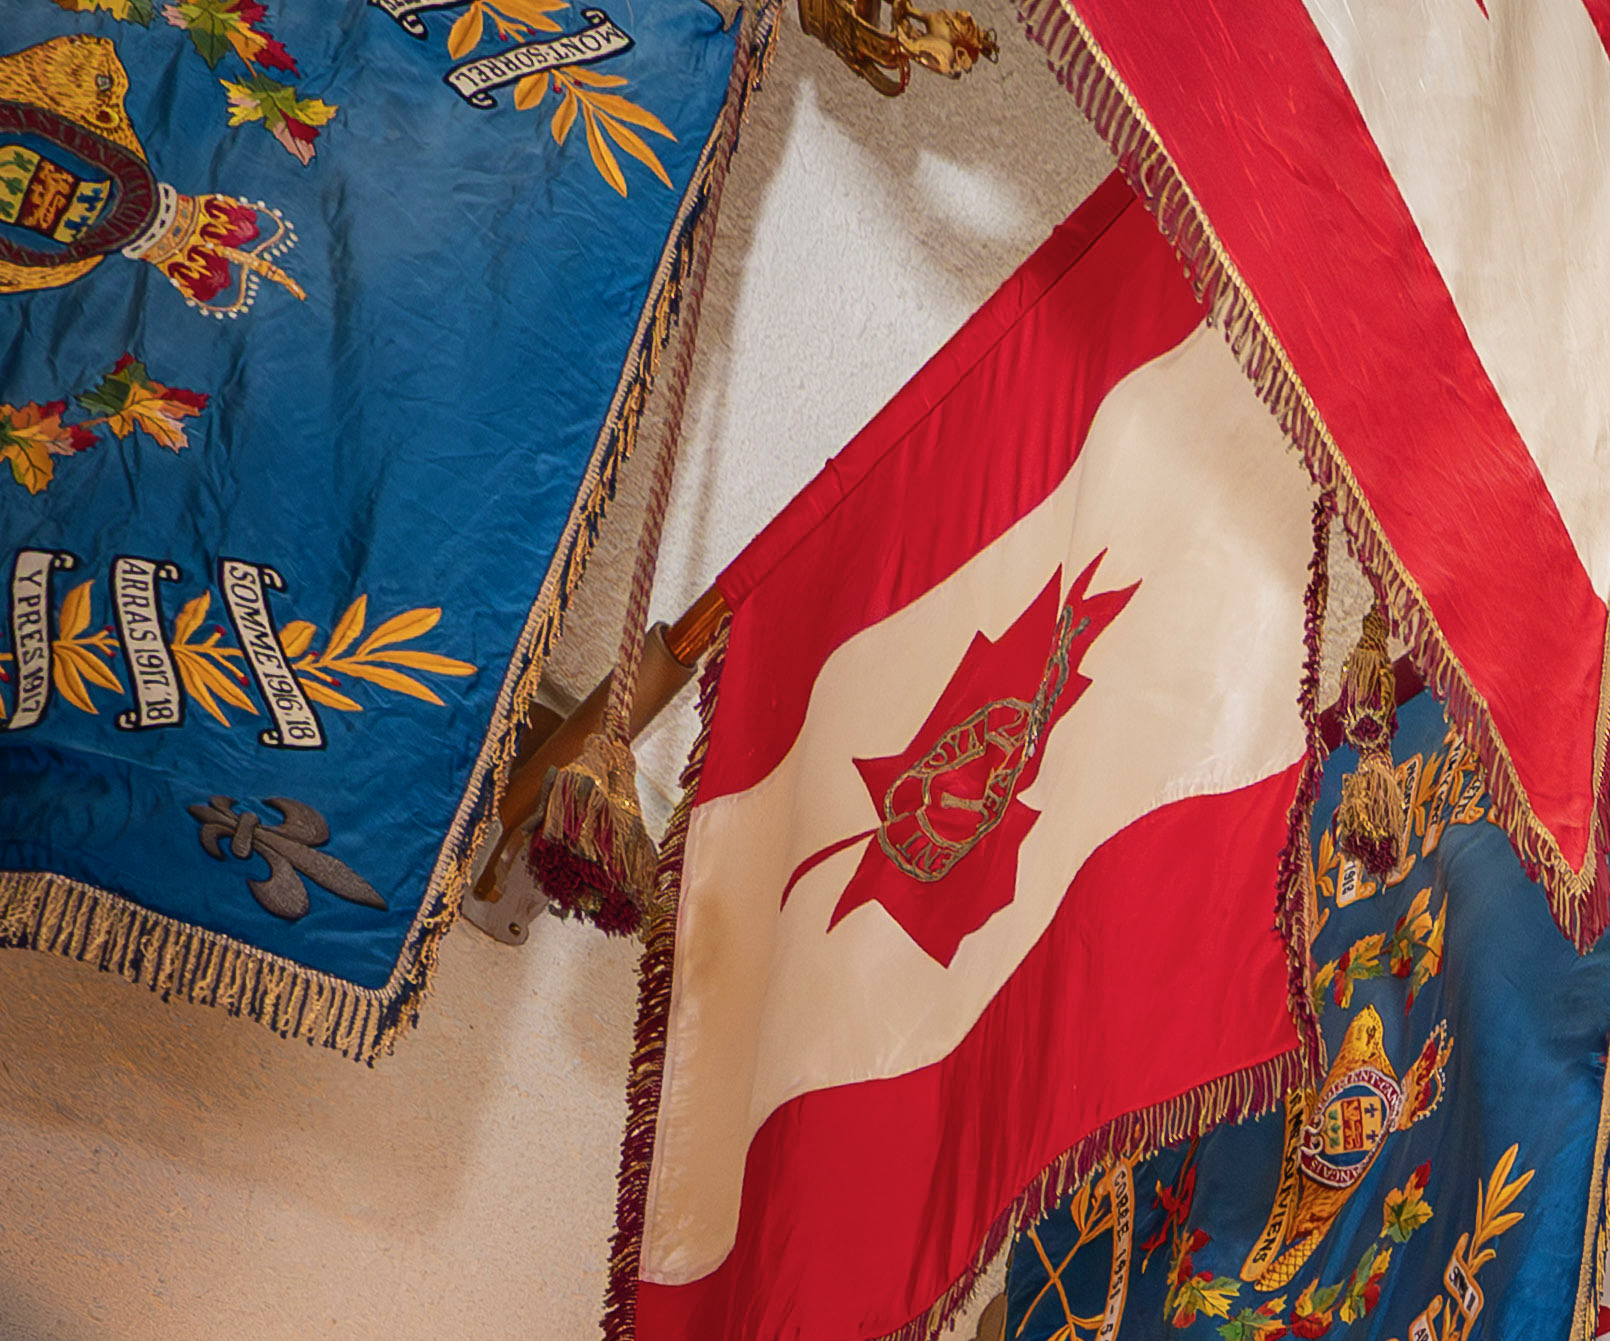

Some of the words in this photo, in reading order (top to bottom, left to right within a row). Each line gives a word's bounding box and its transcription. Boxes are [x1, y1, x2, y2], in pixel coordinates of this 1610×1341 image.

[120, 559, 154, 644] ARRAS
[231, 565, 281, 671] SOMME
[20, 666, 42, 714] 1917
